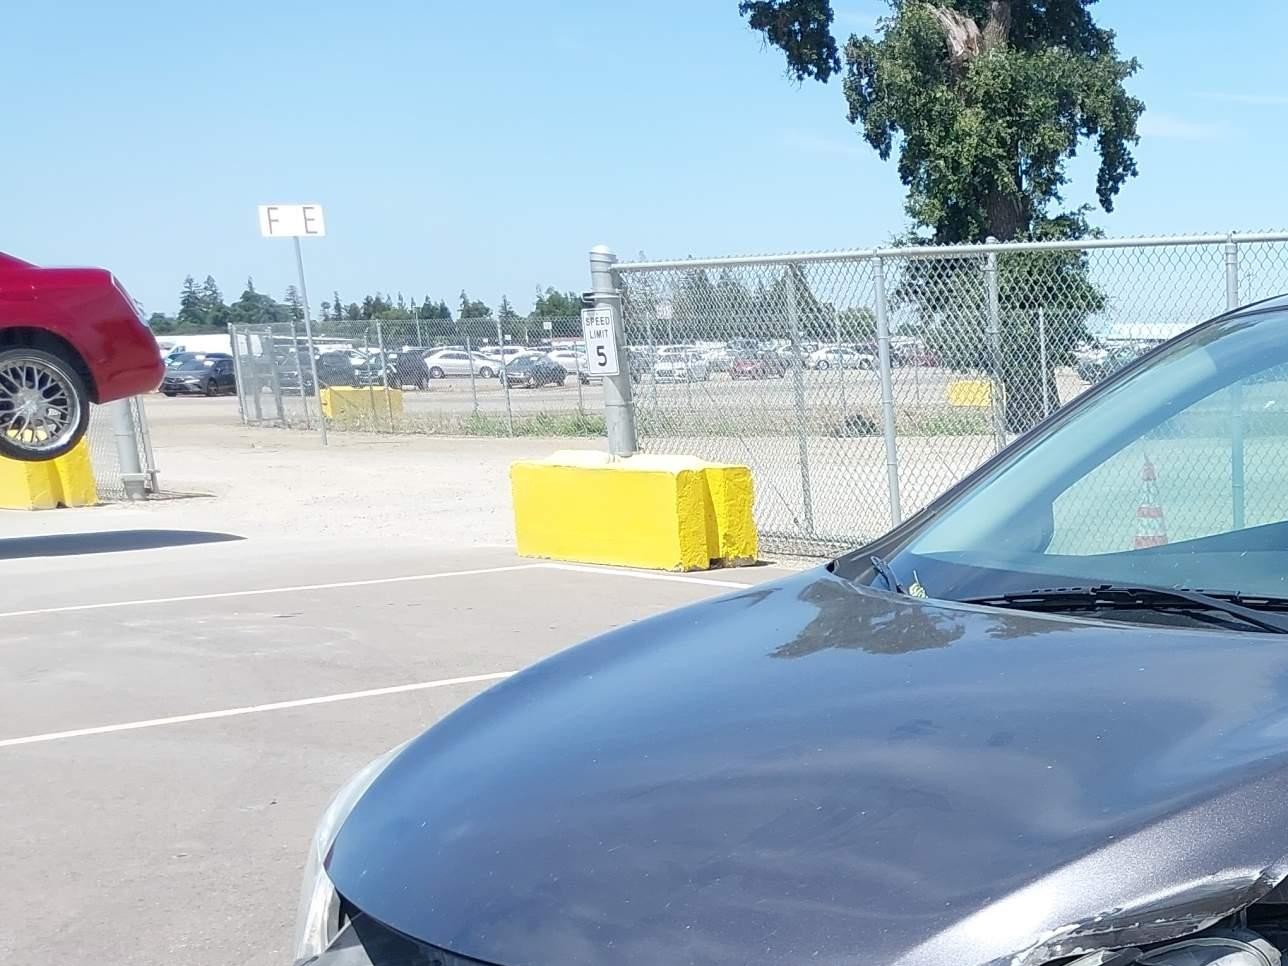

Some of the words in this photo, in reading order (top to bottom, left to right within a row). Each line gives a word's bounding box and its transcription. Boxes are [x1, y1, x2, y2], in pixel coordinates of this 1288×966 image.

[267, 207, 279, 234] F
[302, 206, 318, 234] E
[585, 316, 610, 327] SPEED
[589, 329, 609, 340] LIMIT
[596, 345, 608, 367] 5
